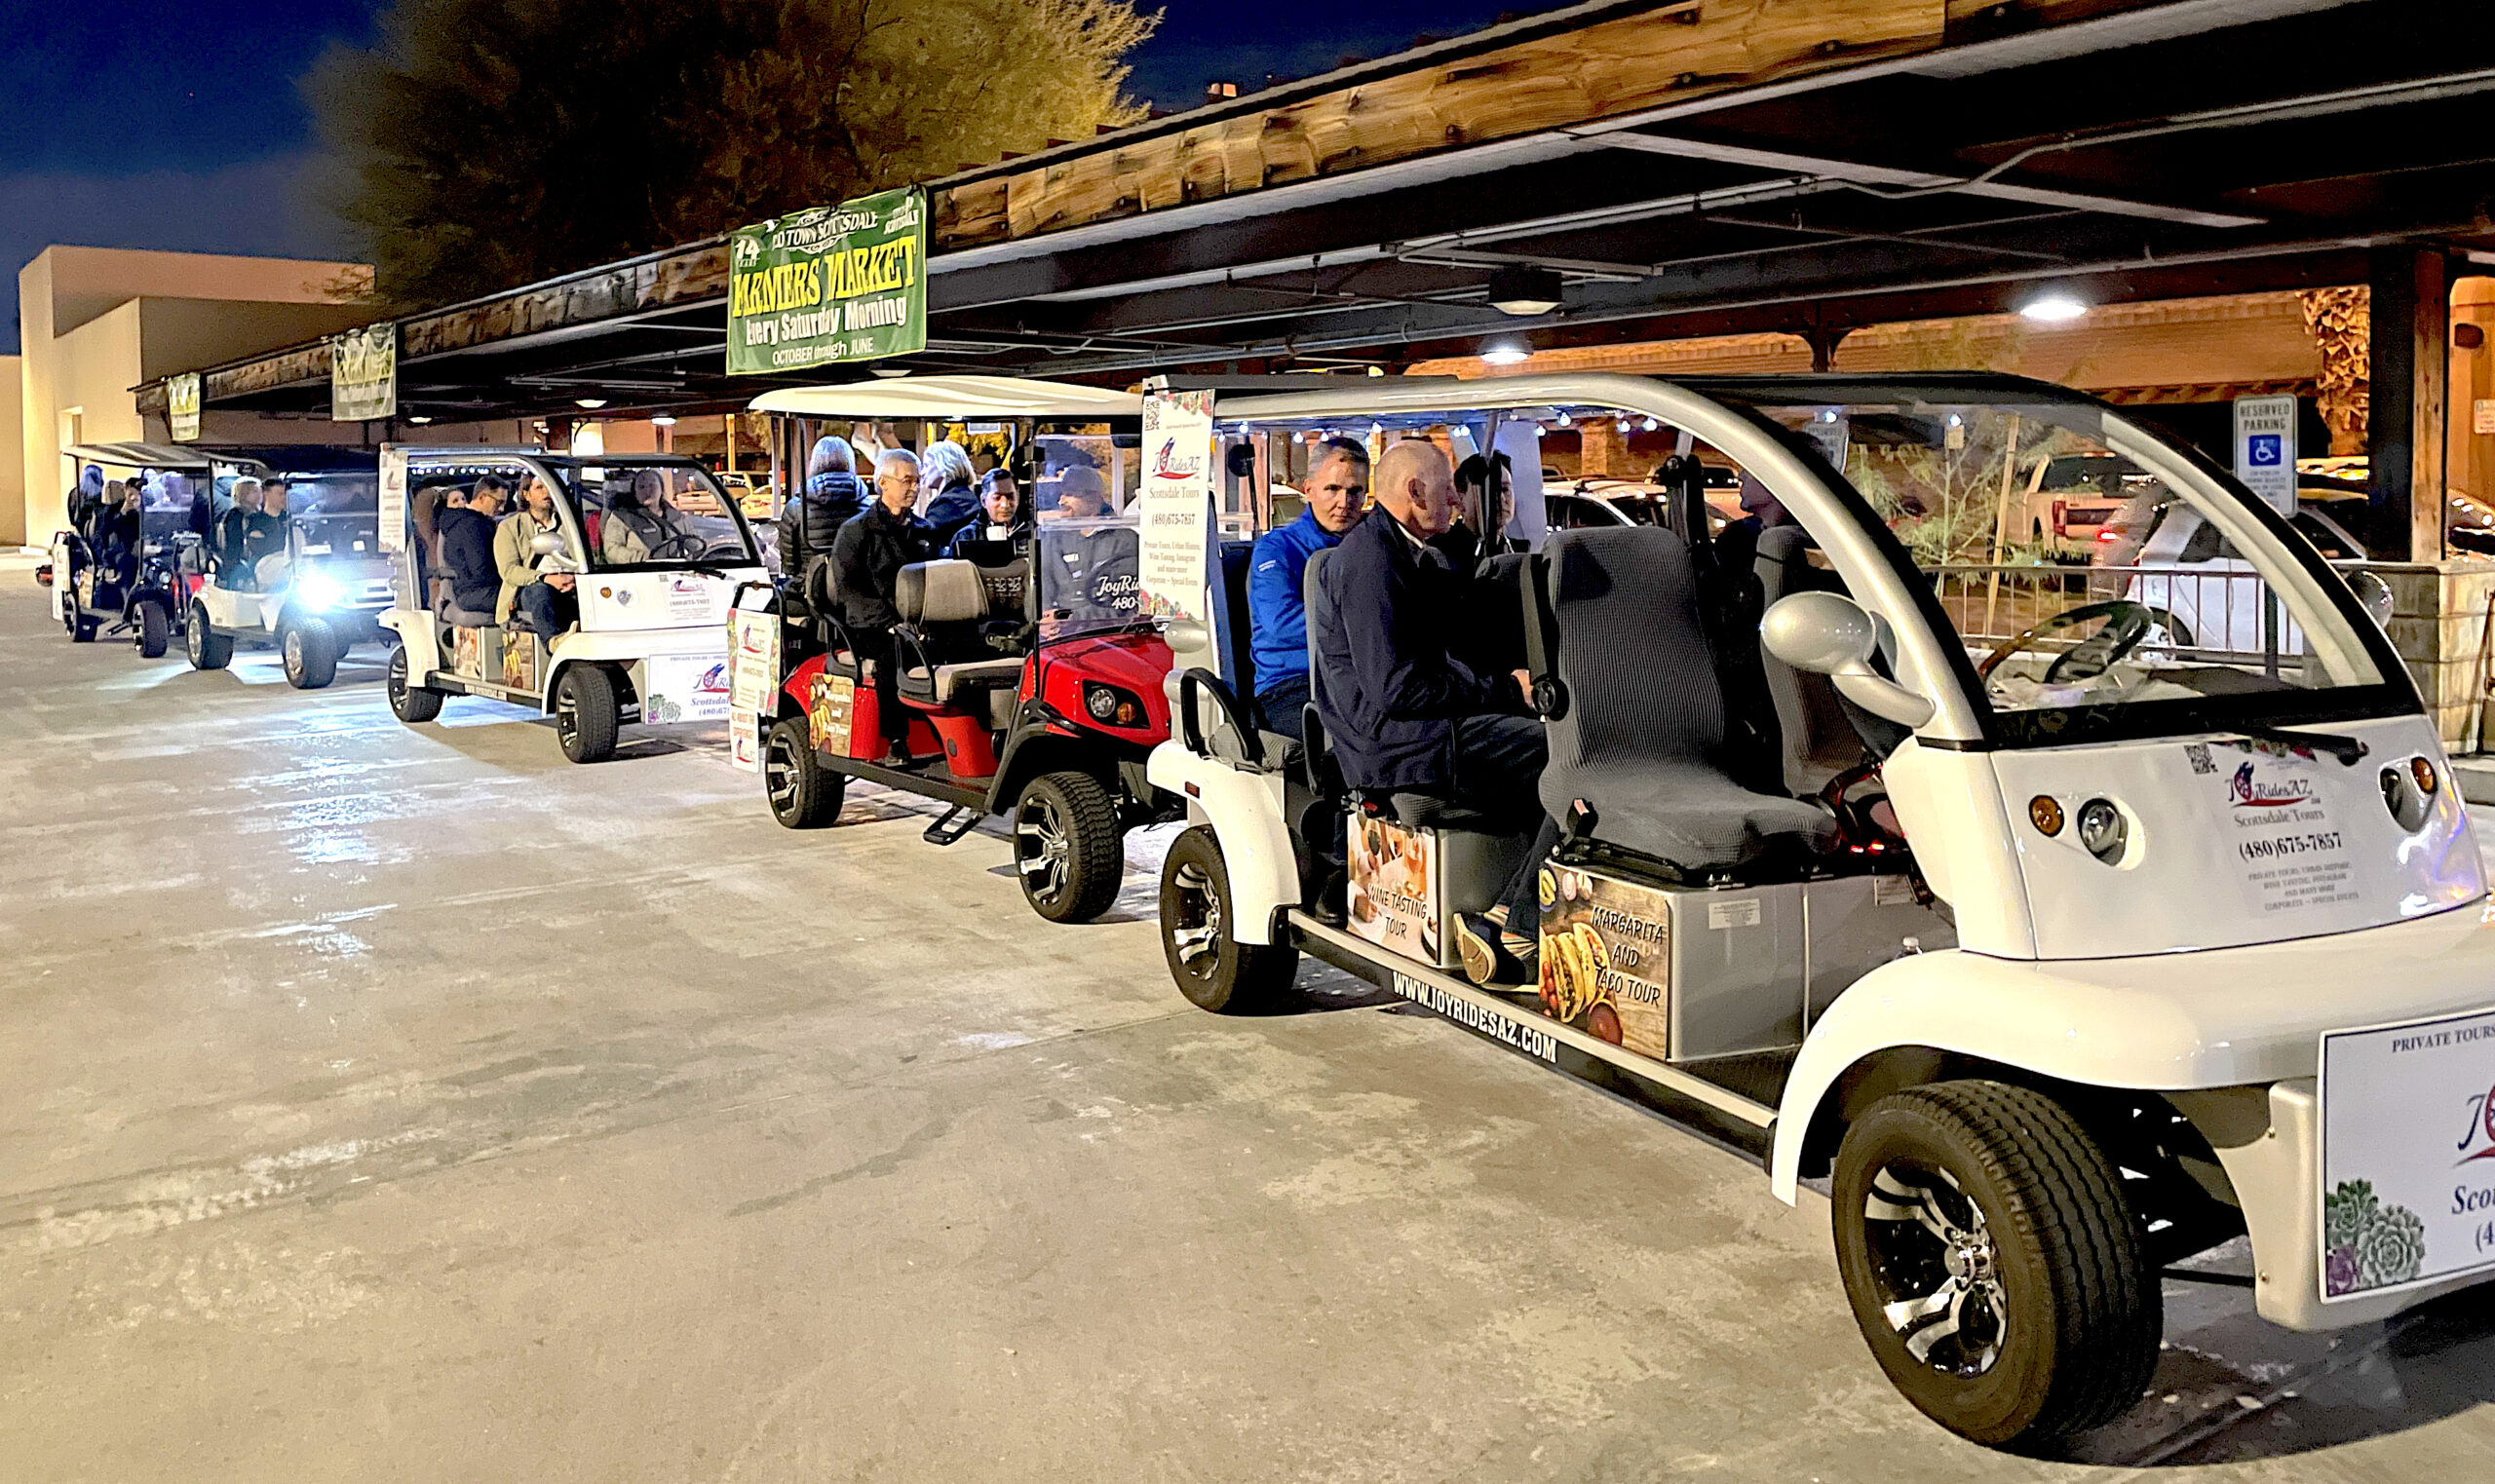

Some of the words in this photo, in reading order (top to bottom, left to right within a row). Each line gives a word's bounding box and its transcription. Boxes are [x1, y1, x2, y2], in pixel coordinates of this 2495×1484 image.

[735, 238, 761, 260] 14
[781, 305, 841, 342] Saturday
[844, 294, 907, 332] Morning
[772, 346, 813, 365] OCTOBER
[814, 340, 847, 360] through
[849, 336, 873, 355] JUNE
[2239, 403, 2291, 418] RESERVED
[2244, 417, 2287, 431] PARKING
[2233, 809, 2289, 828] Scottsdale
[2289, 808, 2325, 822] Tours
[2239, 831, 2342, 863] (480)675-7857
[1367, 883, 1390, 904] WINE
[1391, 891, 1428, 920] TASTING
[1384, 916, 1408, 939] TOUR
[1590, 905, 1664, 945] MARGARITA
[1611, 943, 1639, 968] AND
[1593, 966, 1624, 993] TACO
[1626, 973, 1662, 1008] TOUR
[1392, 970, 1557, 1064] WWW.JOYRIDESAZ.COM
[2392, 1031, 2452, 1053] PRIVATE
